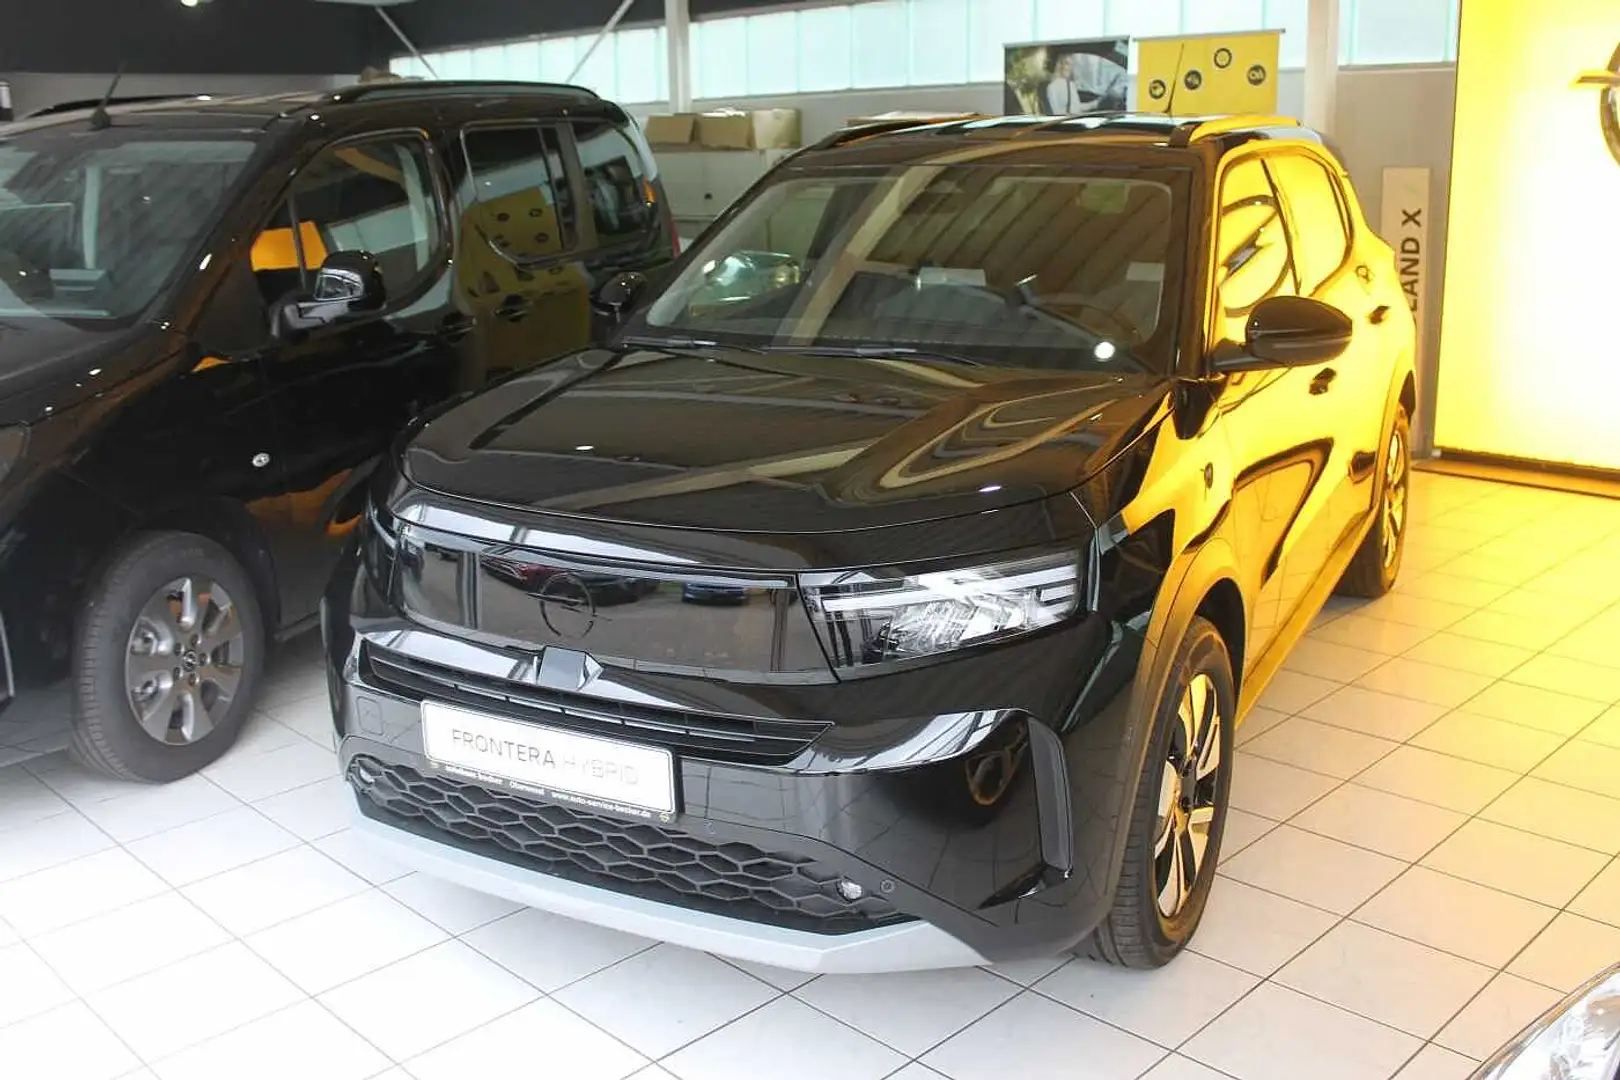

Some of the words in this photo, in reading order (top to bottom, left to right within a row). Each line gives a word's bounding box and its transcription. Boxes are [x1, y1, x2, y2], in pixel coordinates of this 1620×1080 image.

[1401, 207, 1422, 228] X
[452, 728, 556, 770] FRONTERA
[563, 754, 639, 786] HYBRID
